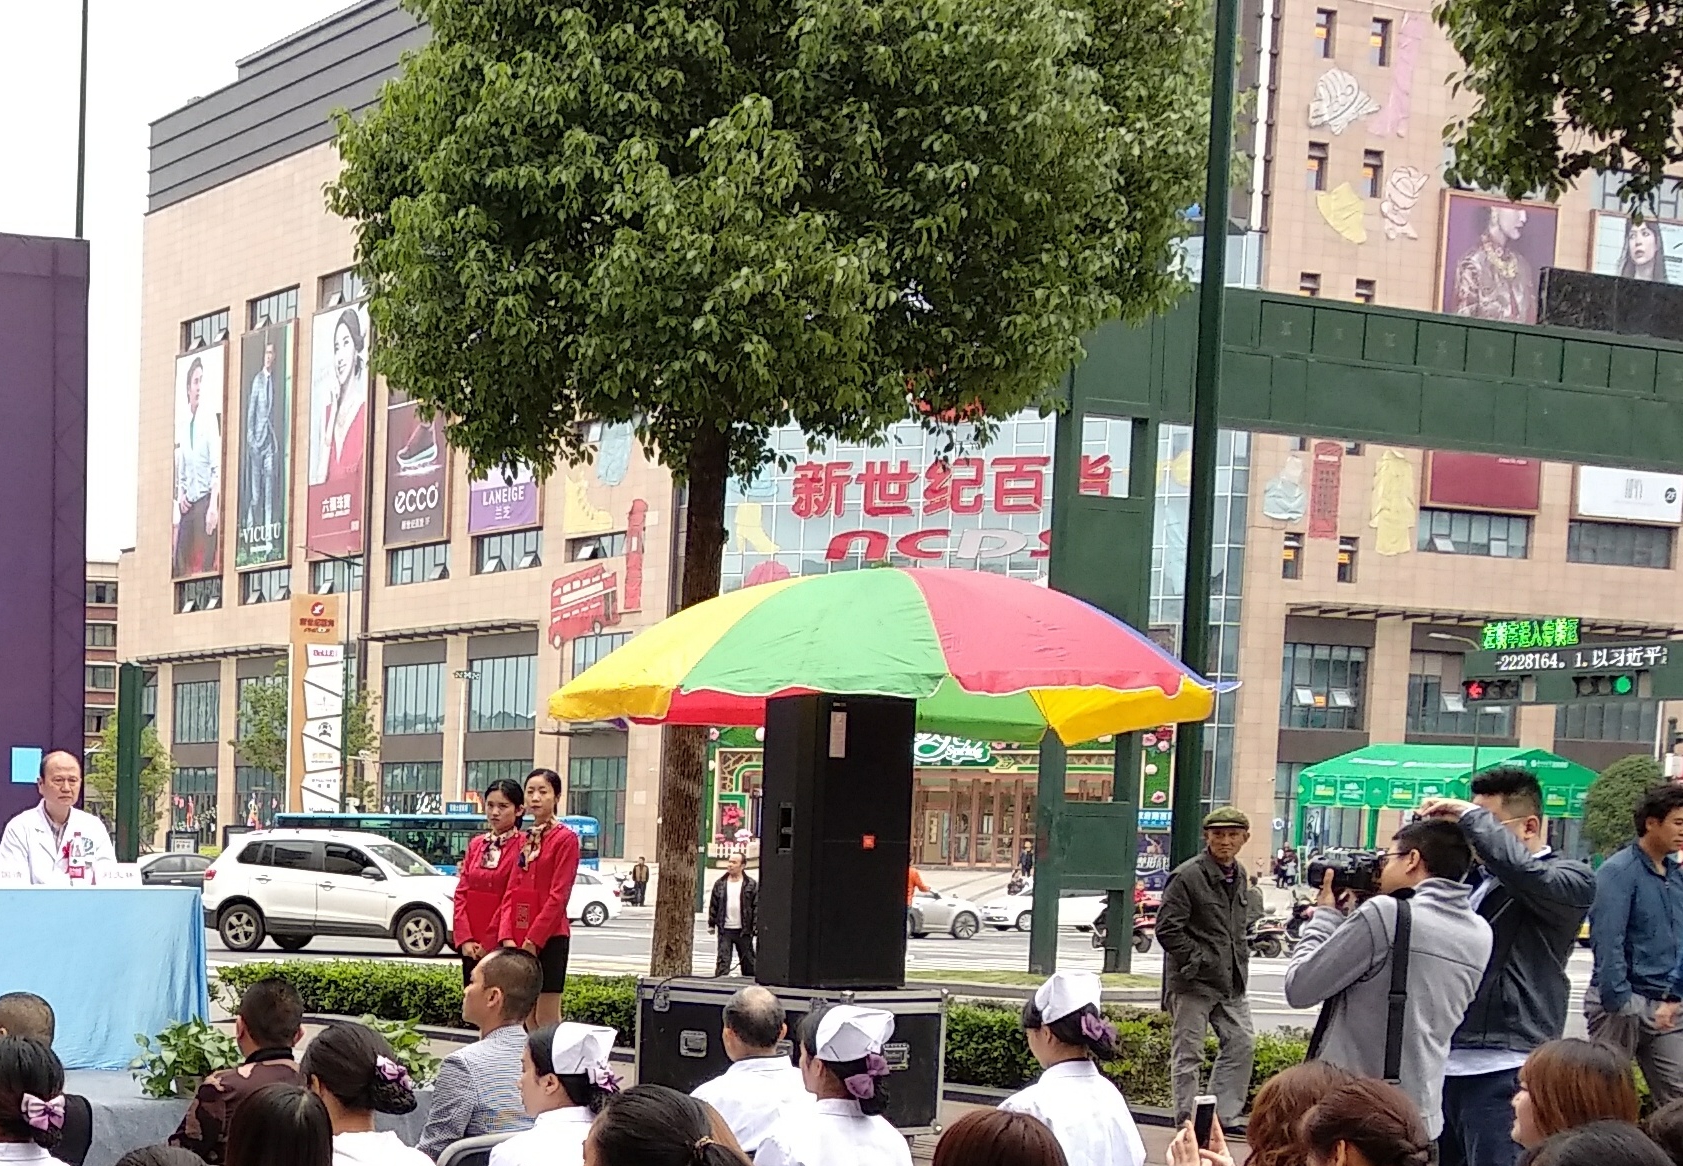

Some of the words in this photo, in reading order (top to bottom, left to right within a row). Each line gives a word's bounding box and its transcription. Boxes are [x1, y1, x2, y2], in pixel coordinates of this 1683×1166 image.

[394, 486, 439, 514] ecco
[482, 485, 525, 506] LANEIGE
[242, 522, 281, 543] VICUTU
